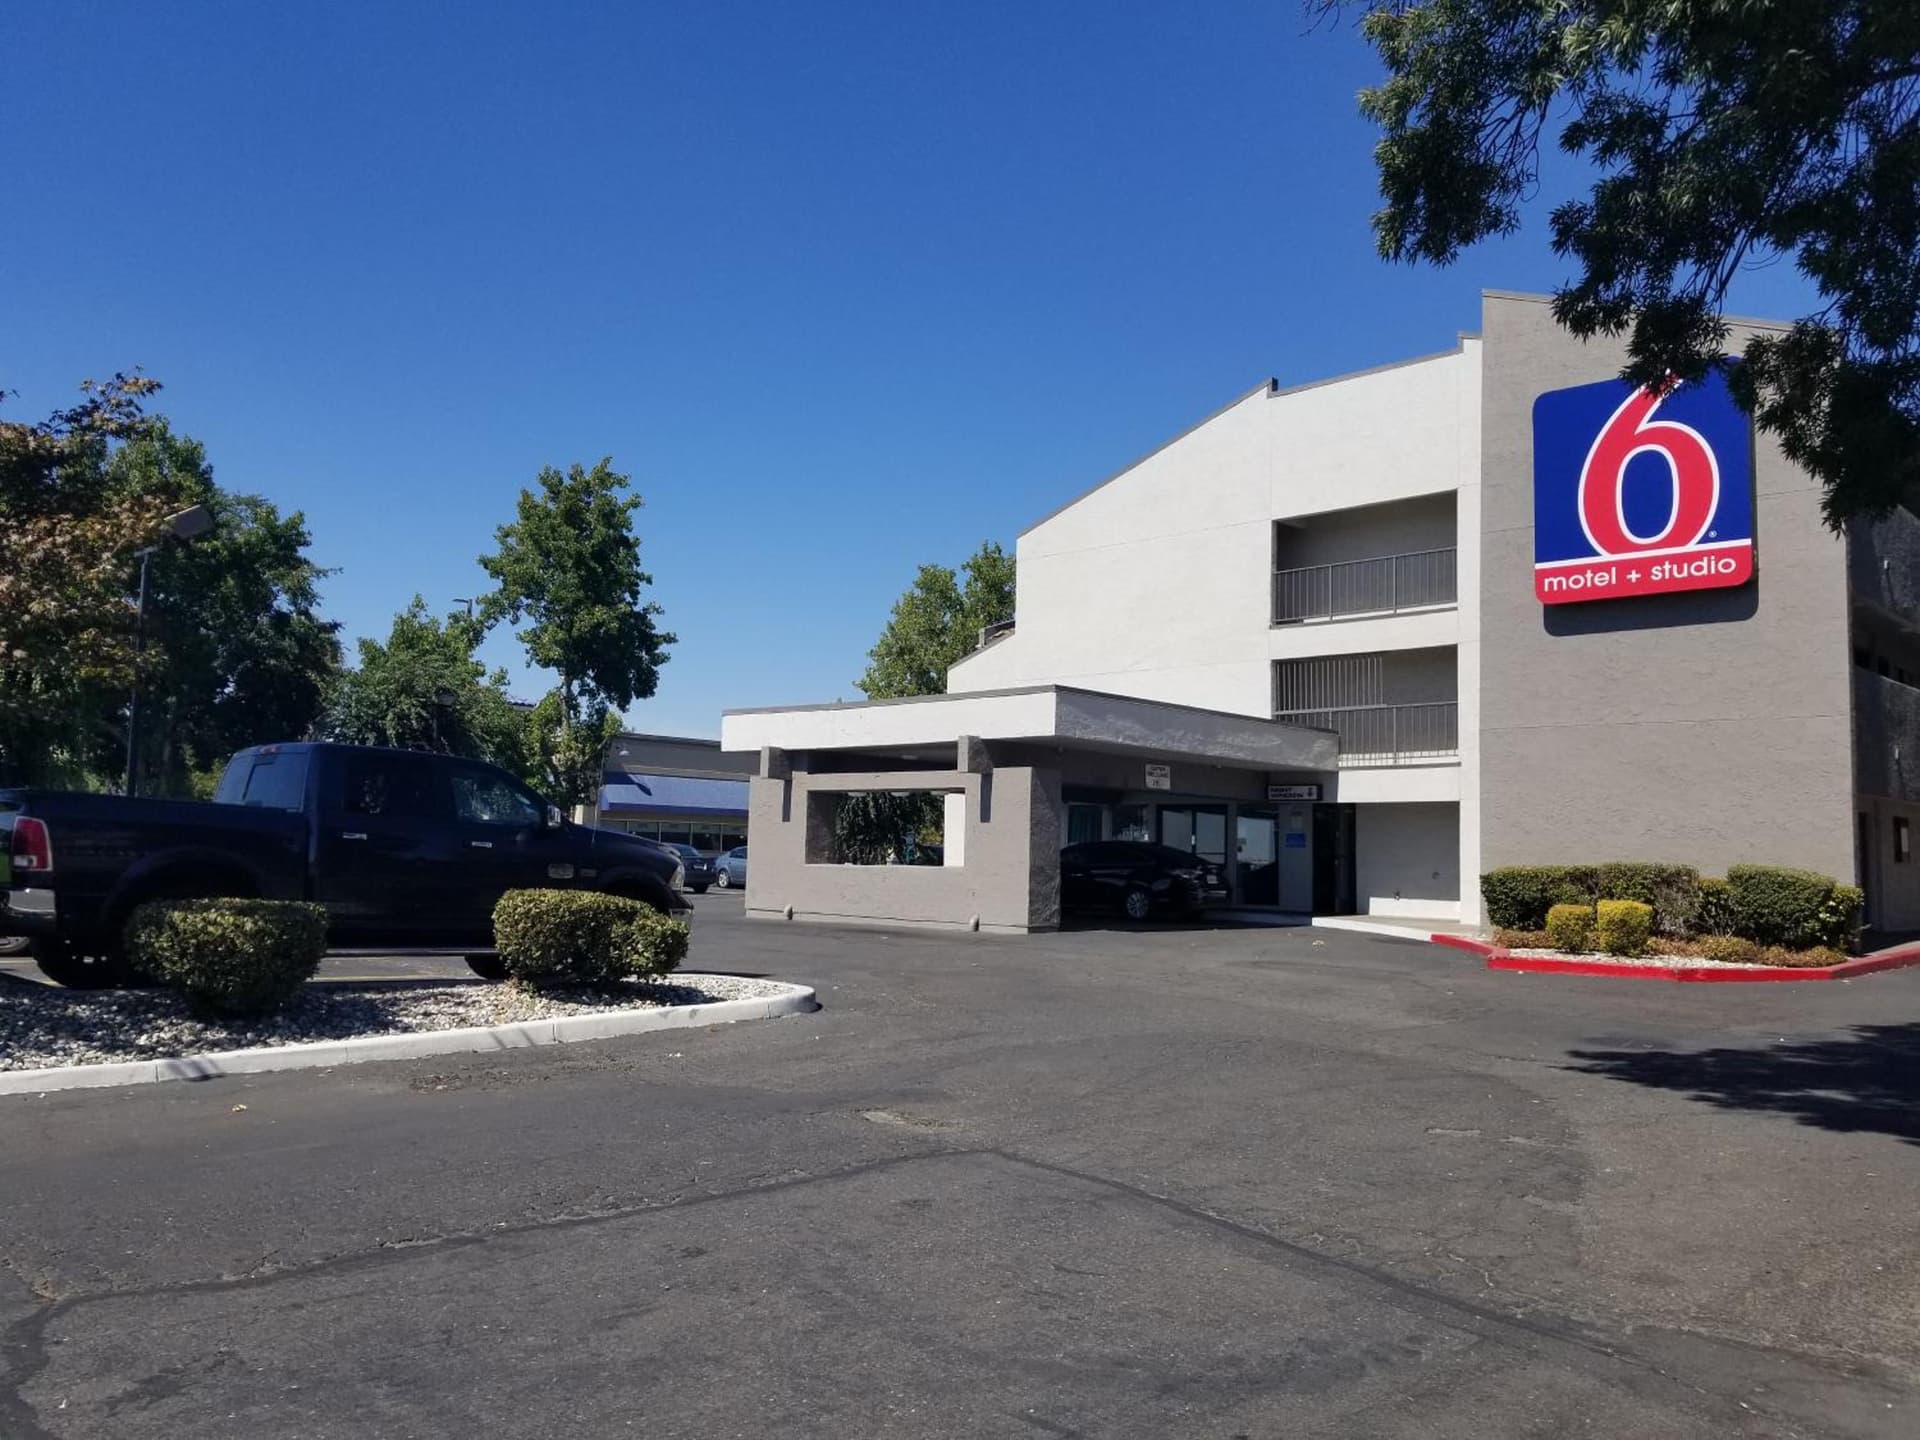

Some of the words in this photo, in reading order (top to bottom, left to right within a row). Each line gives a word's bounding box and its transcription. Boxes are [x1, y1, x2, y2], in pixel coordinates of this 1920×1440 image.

[1578, 366, 1720, 556] 6
[1544, 566, 1617, 593] motel
[1651, 556, 1737, 581] studio
